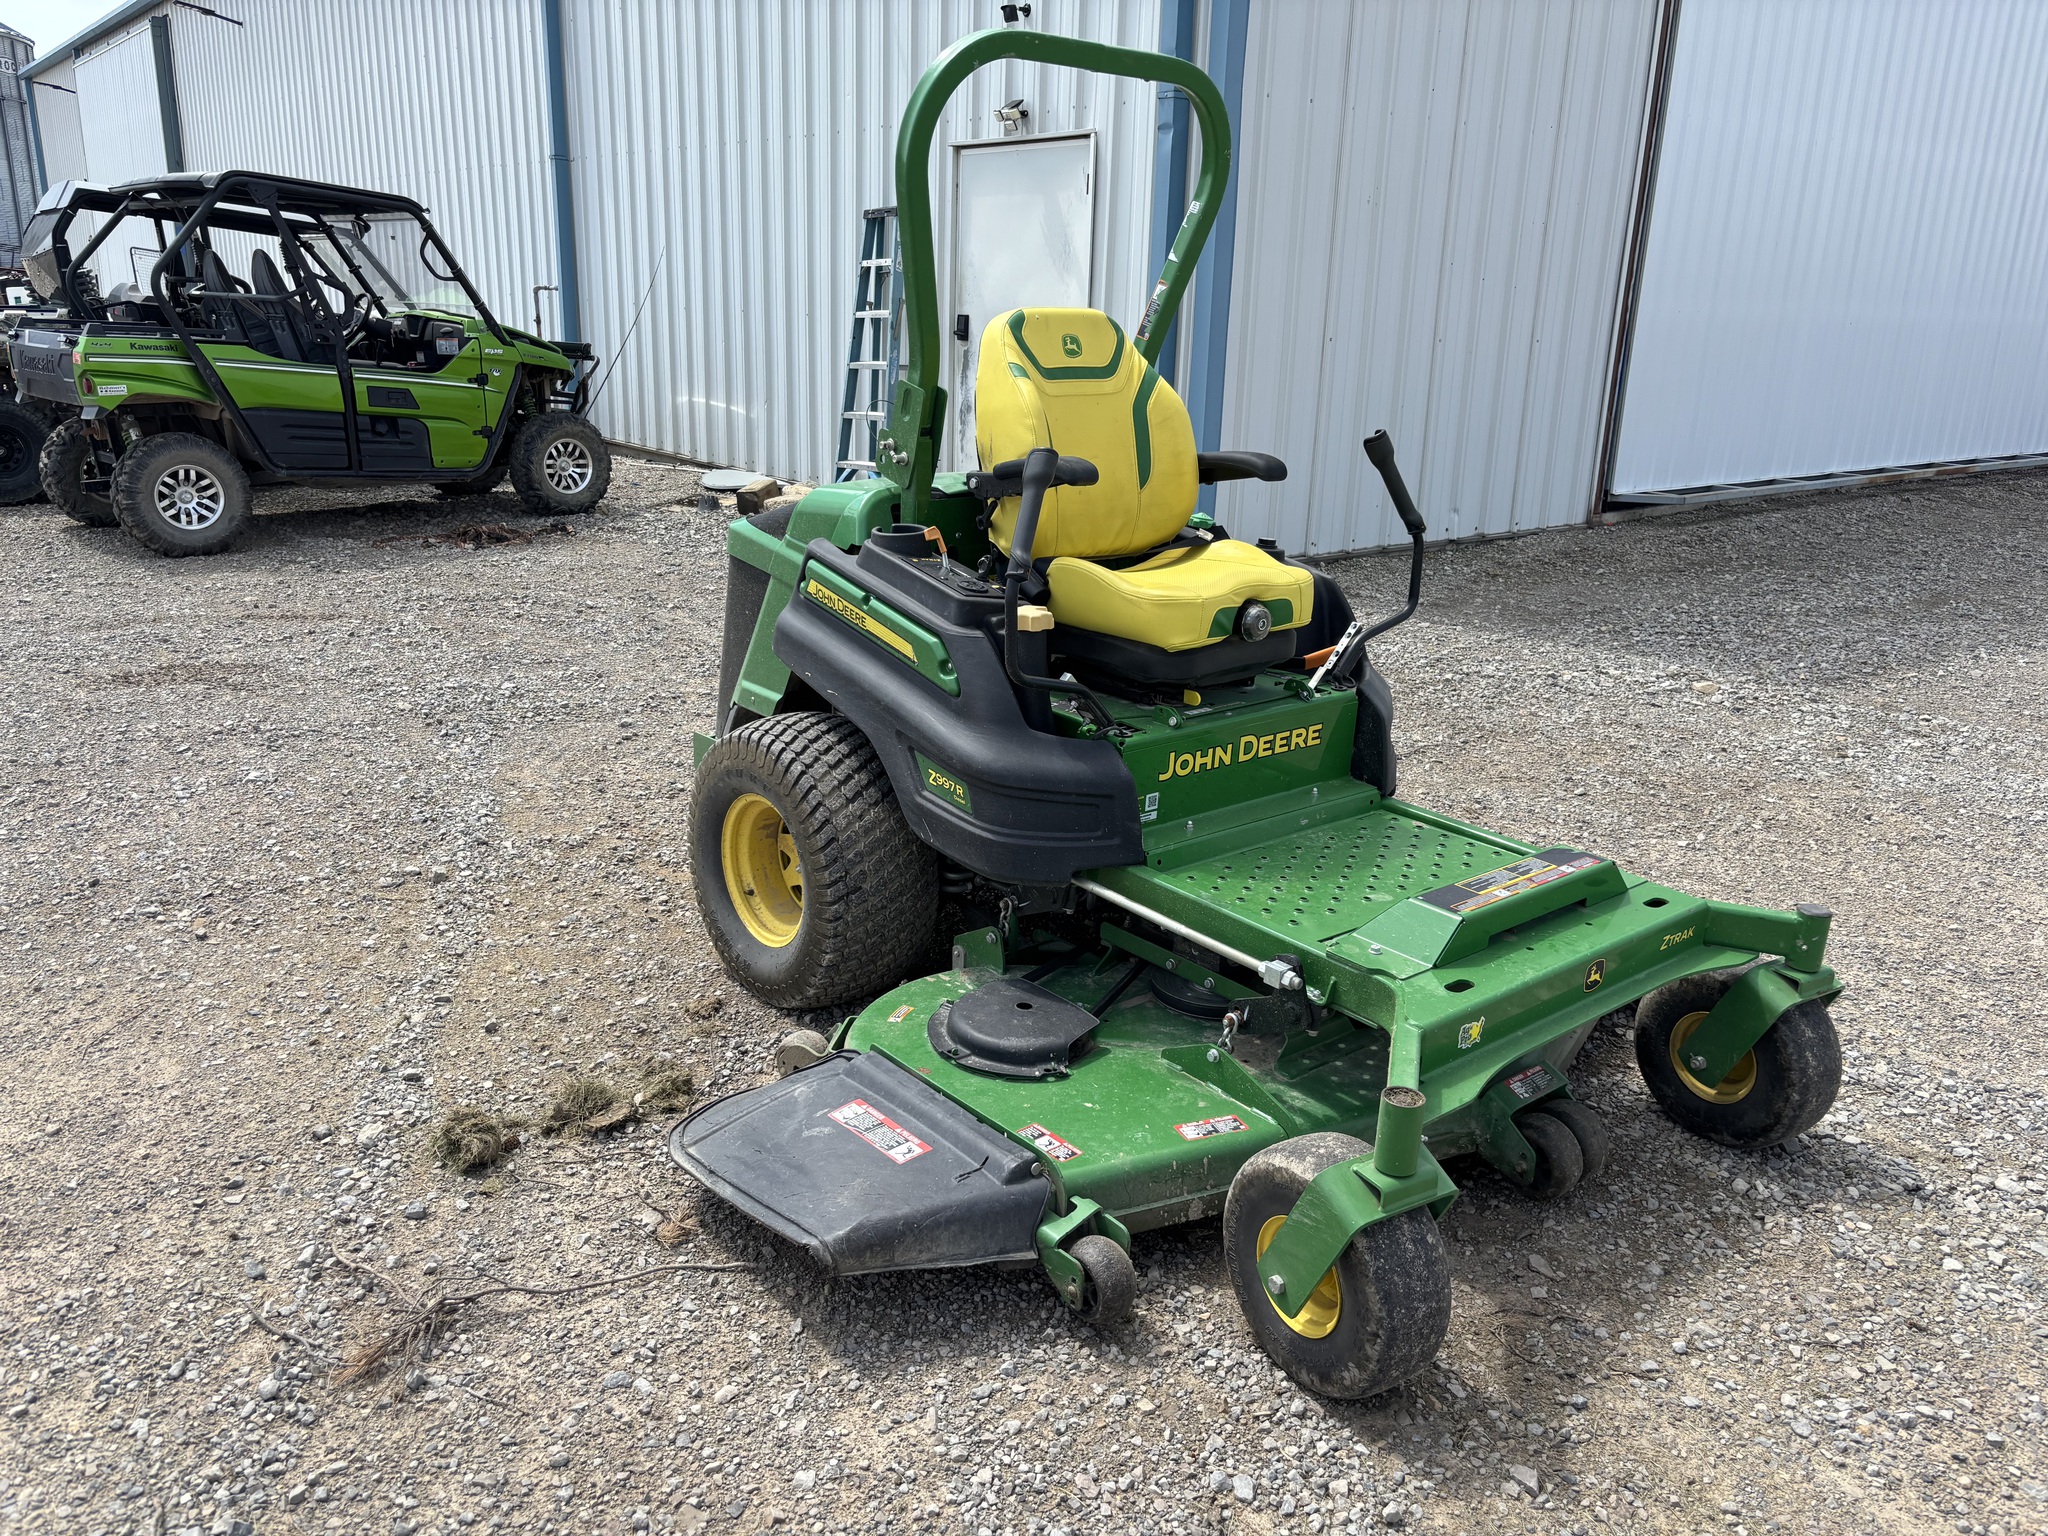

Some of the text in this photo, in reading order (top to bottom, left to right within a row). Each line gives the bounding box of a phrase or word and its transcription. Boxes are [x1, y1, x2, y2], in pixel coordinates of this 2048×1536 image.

[20, 350, 55, 375] Kawasaki
[130, 342, 178, 352] Kawasaki
[812, 584, 867, 629] JOHN DEERE
[1158, 722, 1324, 782] JOHN DEERE
[710, 909, 752, 973] KENDA
[1660, 926, 1696, 951] ZTRAK
